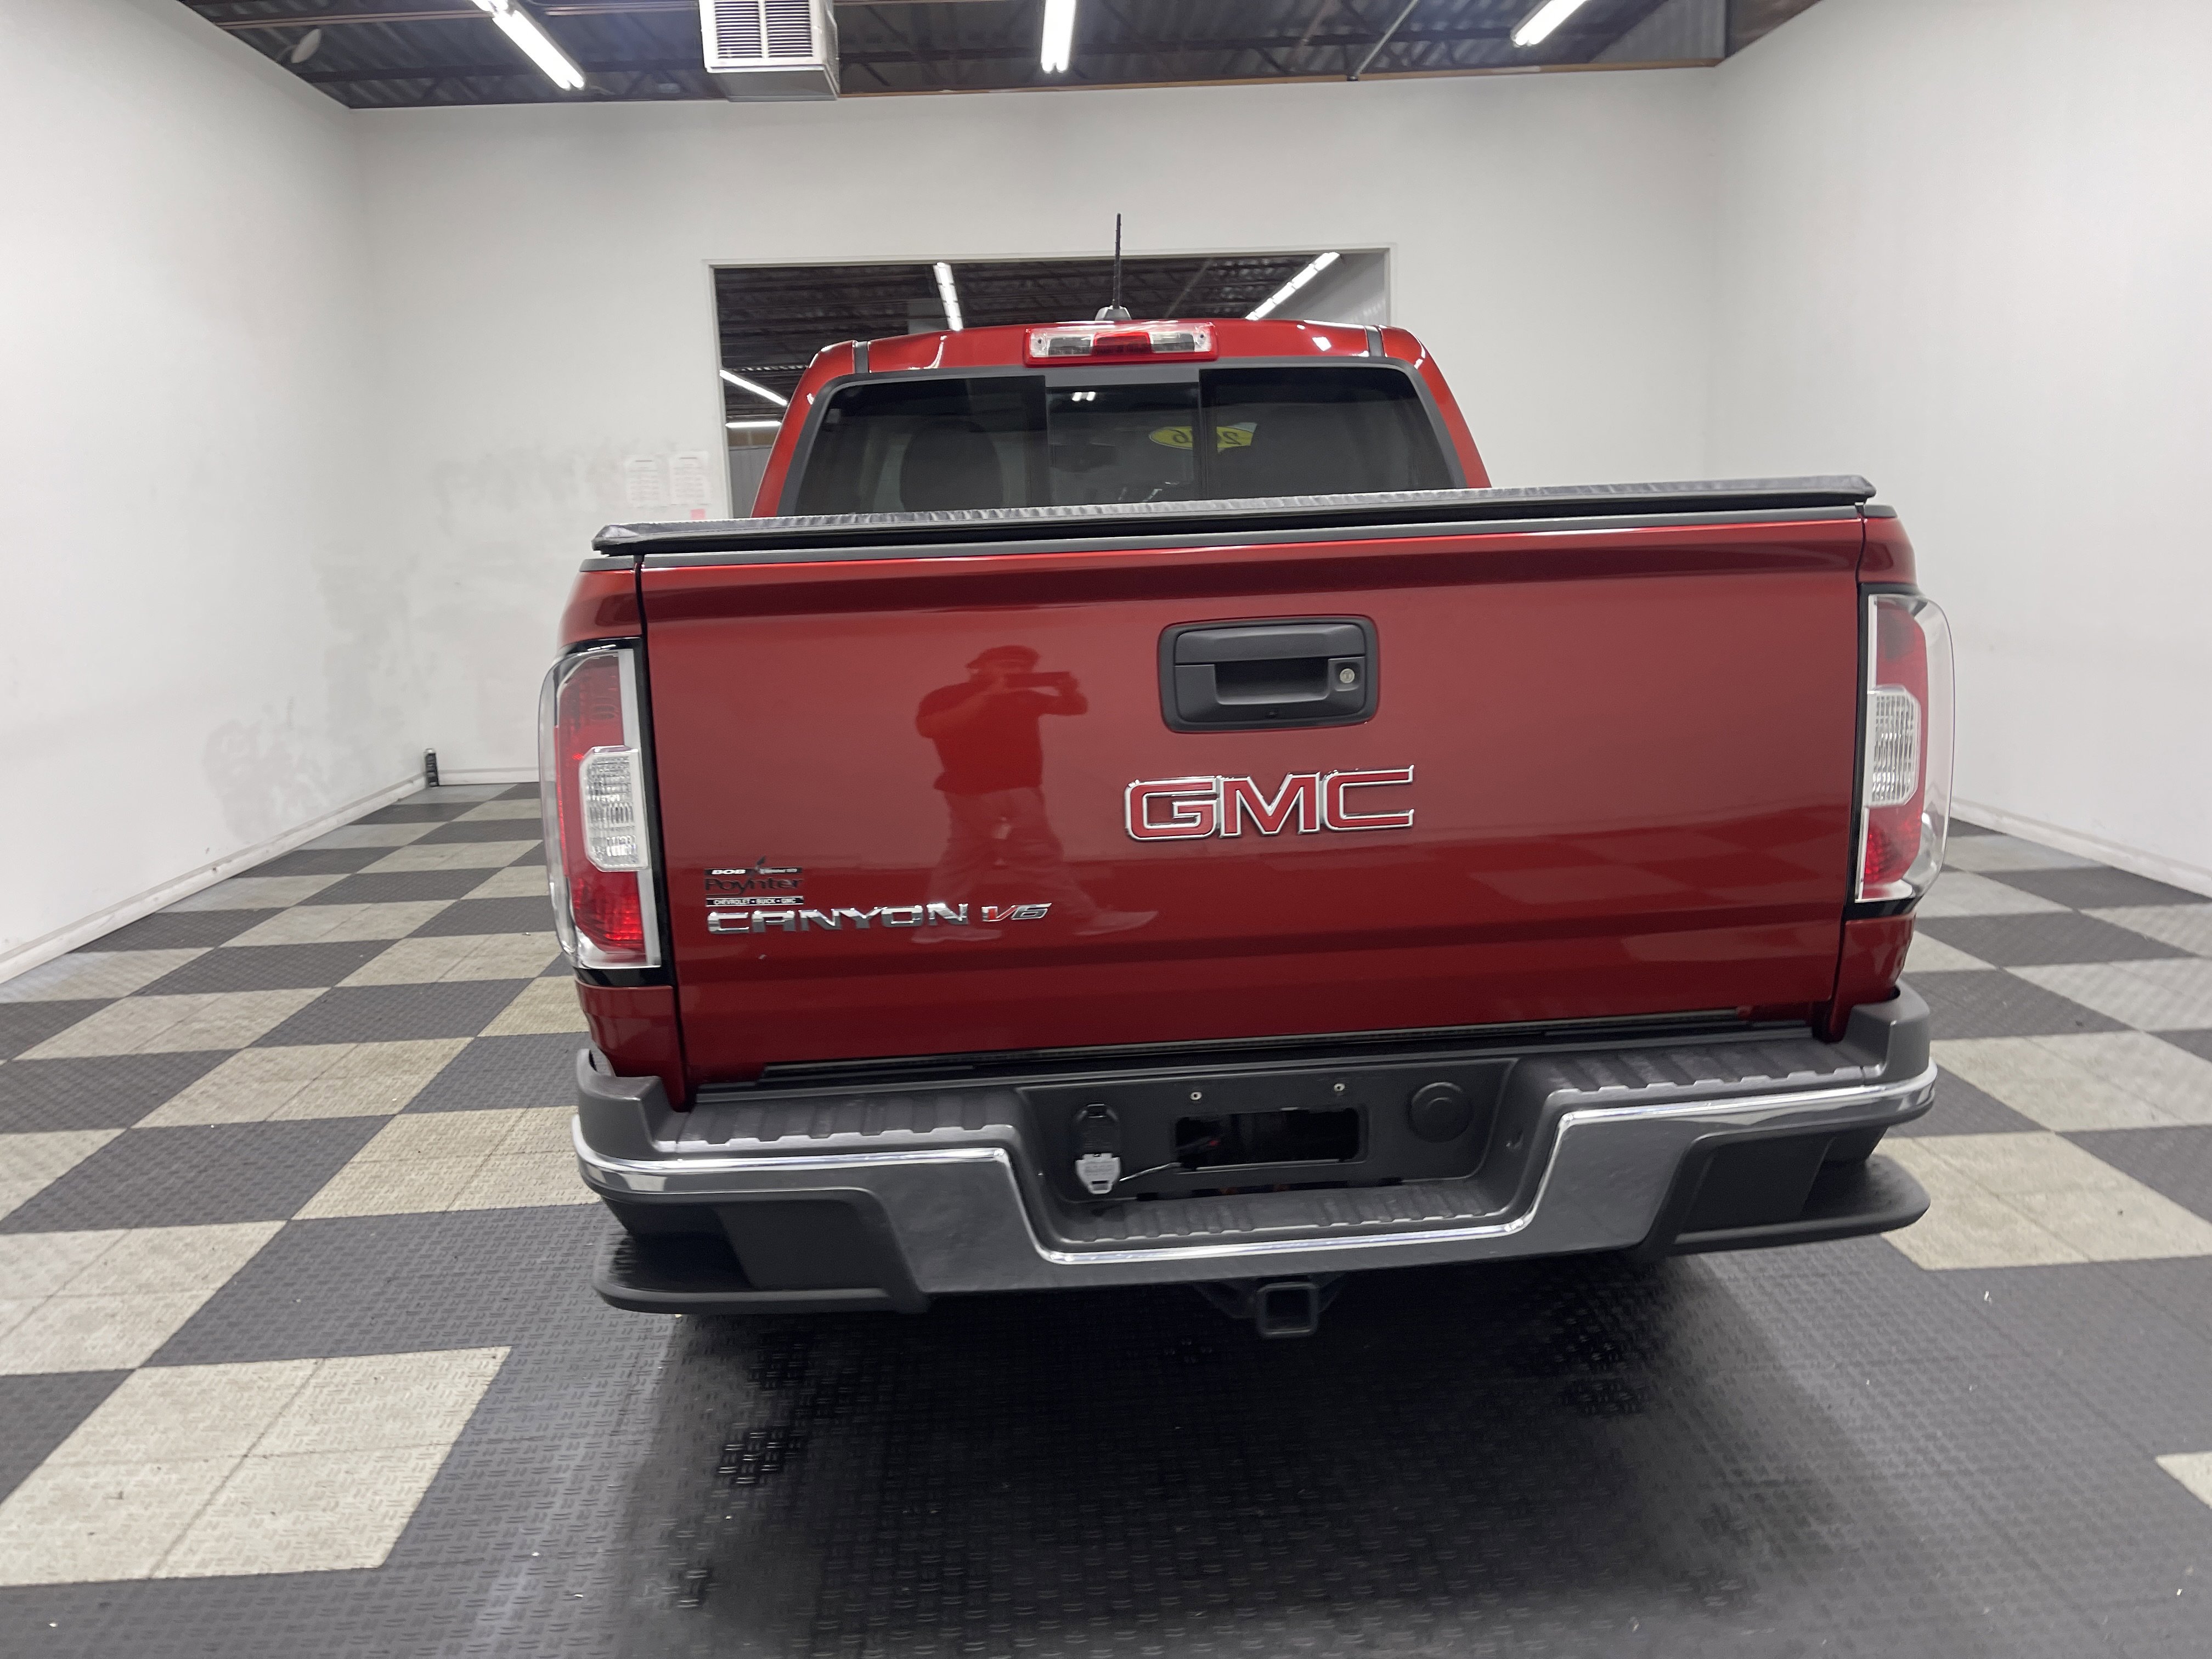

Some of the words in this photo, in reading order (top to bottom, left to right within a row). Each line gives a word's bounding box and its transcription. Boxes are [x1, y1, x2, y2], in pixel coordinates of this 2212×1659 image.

[1125, 765, 1415, 842] GMC
[704, 875, 804, 896] Poynter
[707, 902, 969, 933] CANYON
[981, 902, 1052, 922] V6
